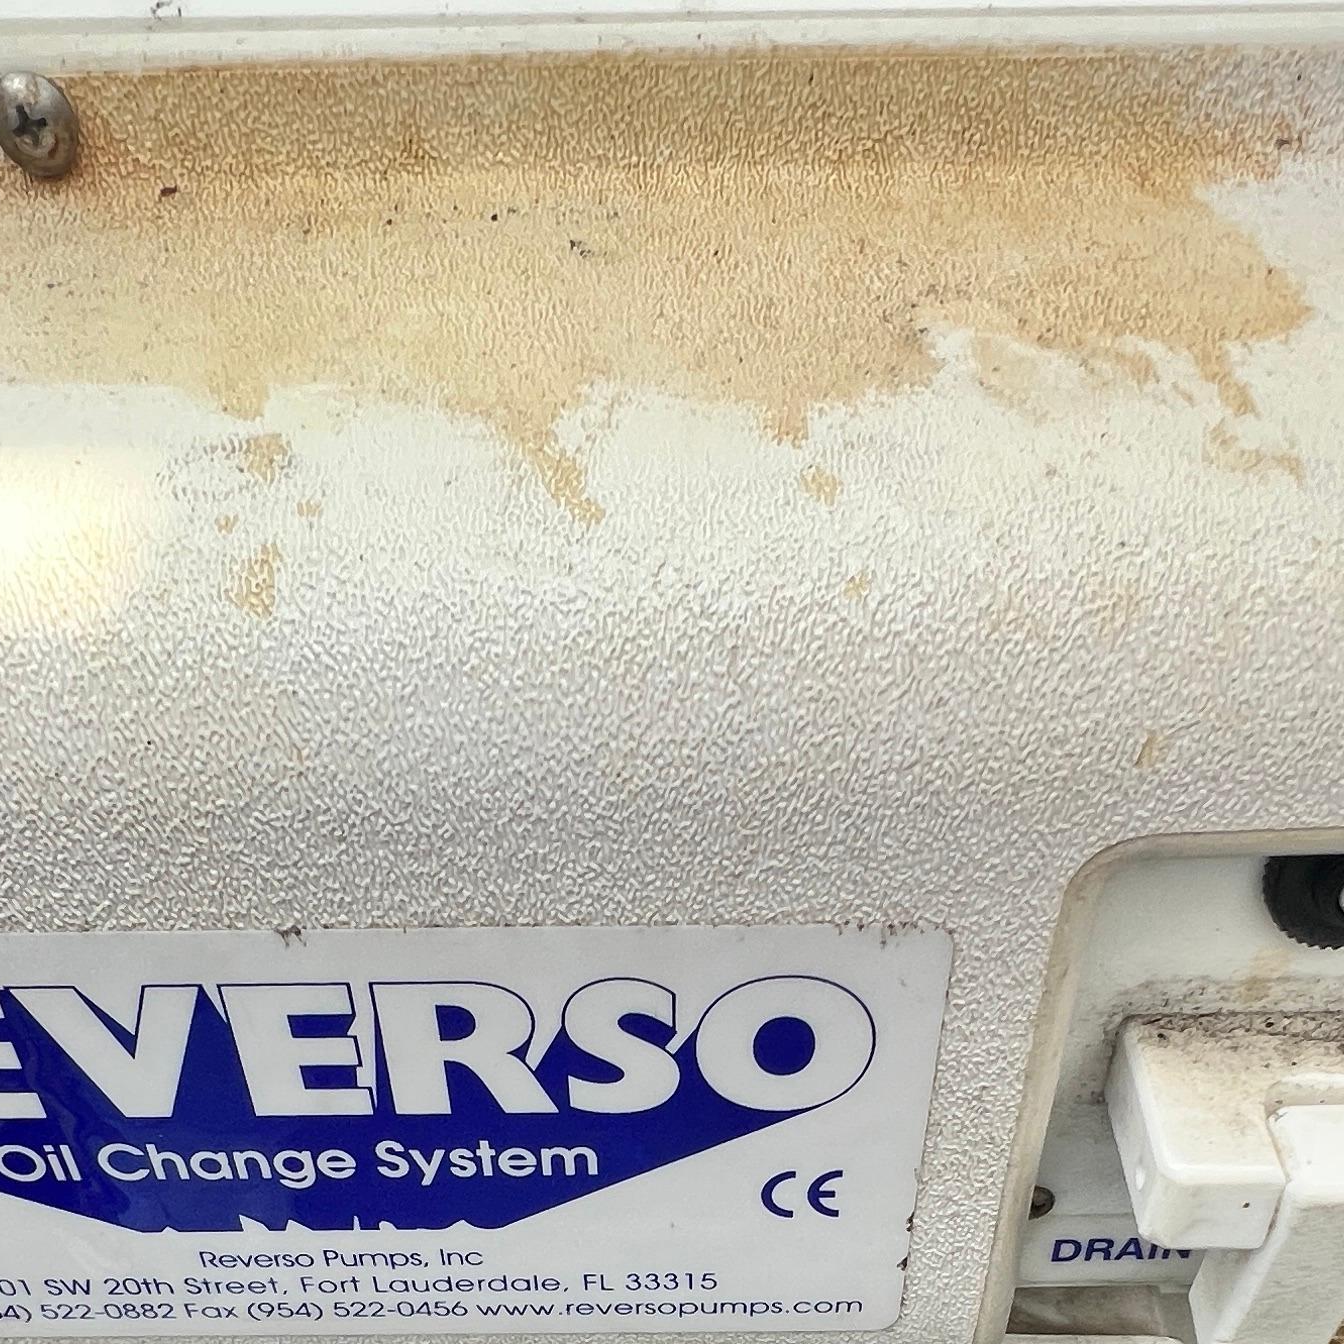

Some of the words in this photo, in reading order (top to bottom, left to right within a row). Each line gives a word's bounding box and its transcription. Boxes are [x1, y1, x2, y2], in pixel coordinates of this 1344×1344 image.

[97, 1142, 357, 1189] Change
[376, 1139, 599, 1186] System
[200, 1250, 315, 1268] Reverso
[323, 1249, 430, 1270] Pumps,
[440, 1248, 484, 1266] Inc
[44, 1278, 91, 1296] SW
[104, 1277, 175, 1296] 20th
[184, 1275, 288, 1296] Street,
[300, 1275, 361, 1294] Fort
[372, 1274, 569, 1294] Lauderdale,
[583, 1273, 614, 1292] FL
[625, 1272, 718, 1291] 33315
[40, 1303, 177, 1320] 522-0882
[184, 1302, 240, 1319] Fax
[247, 1301, 323, 1322] (954)
[333, 1300, 469, 1319] 522-0456
[475, 1299, 864, 1319] www.reversopumps.com
